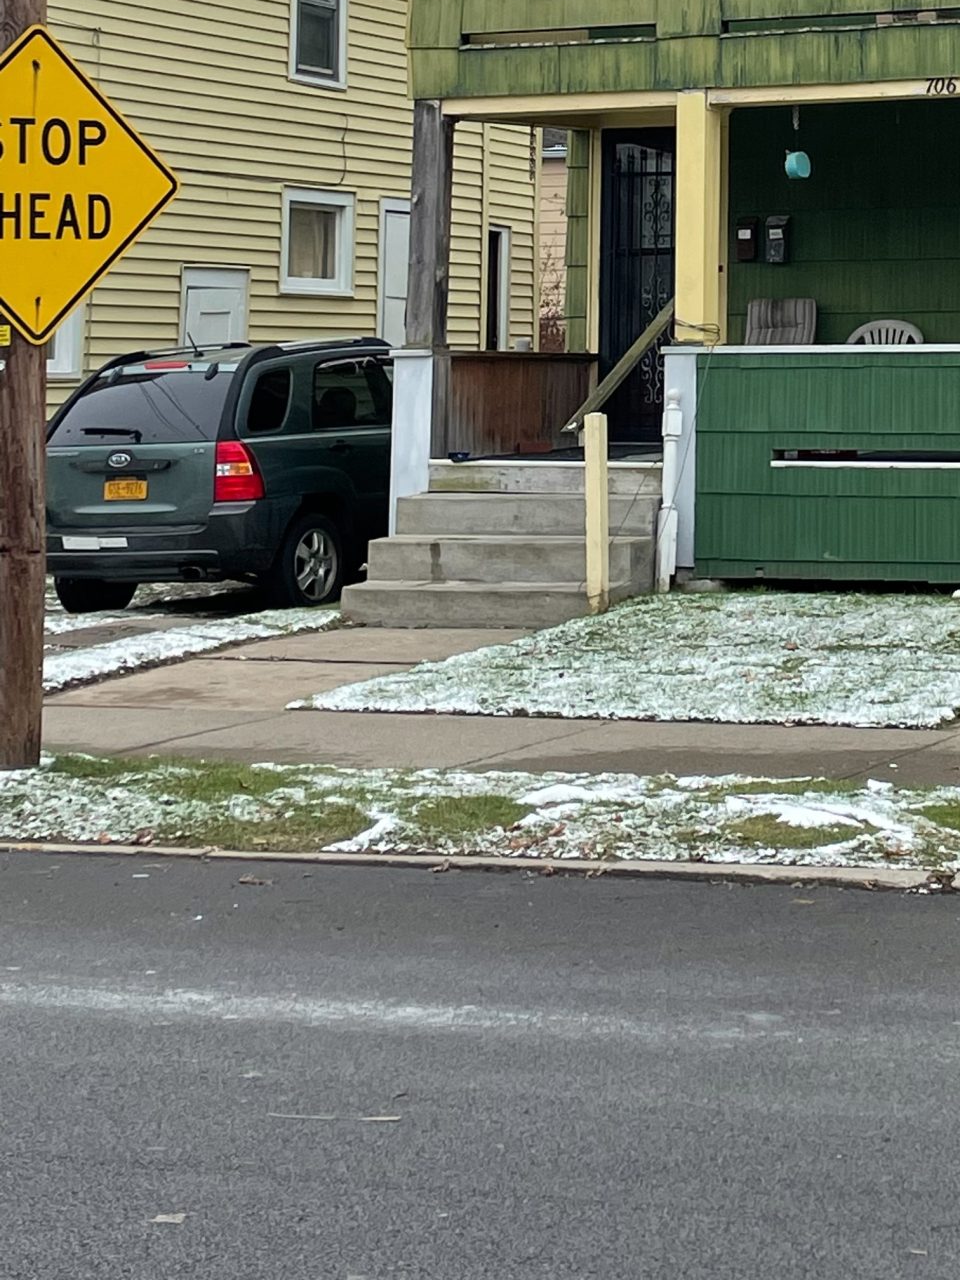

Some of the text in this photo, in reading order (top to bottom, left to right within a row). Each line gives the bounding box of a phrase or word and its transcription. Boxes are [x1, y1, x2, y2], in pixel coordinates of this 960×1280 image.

[926, 77, 958, 94] 706
[0, 117, 107, 165] TOP
[0, 192, 111, 240] HEAD
